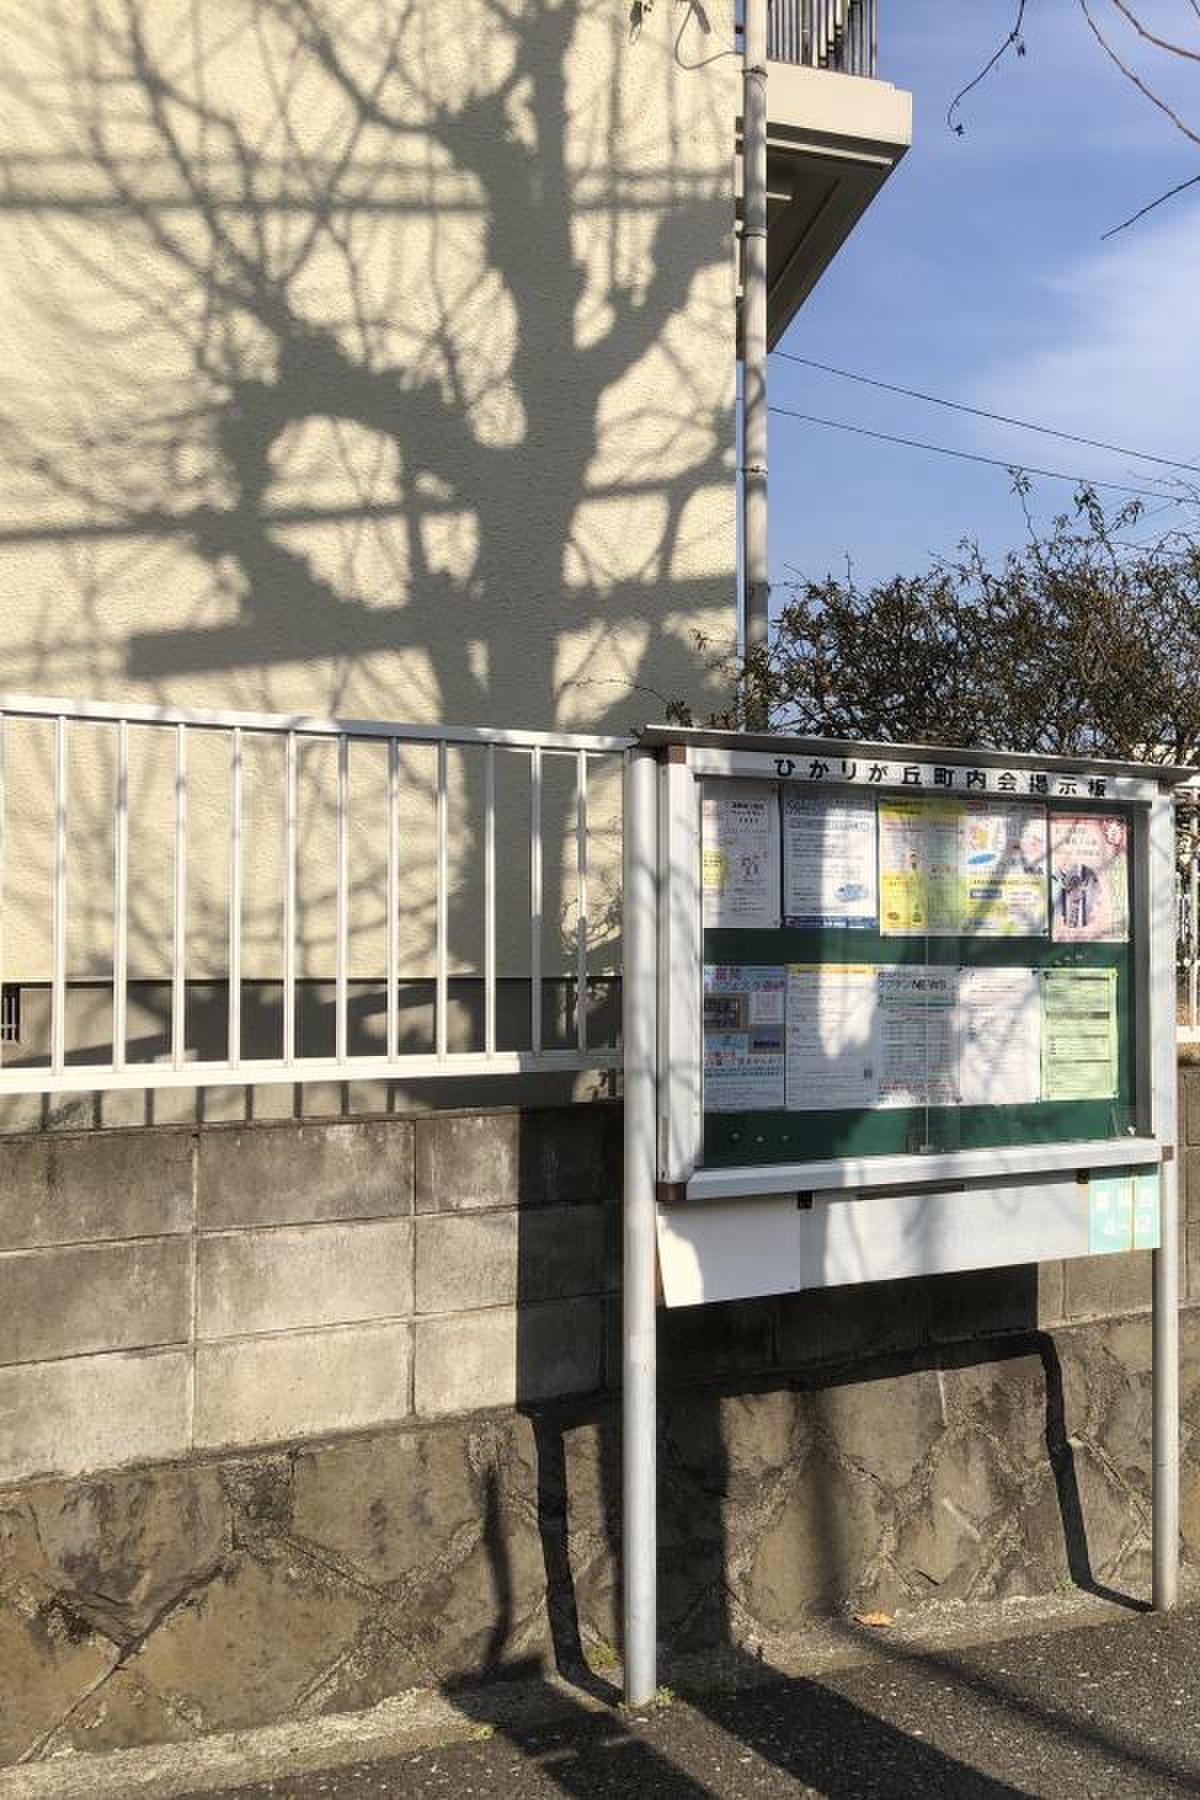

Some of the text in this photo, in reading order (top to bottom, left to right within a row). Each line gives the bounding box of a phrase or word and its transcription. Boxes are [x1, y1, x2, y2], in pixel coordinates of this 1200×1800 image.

[773, 757, 1107, 799] ひかりが丘町内会掲示板
